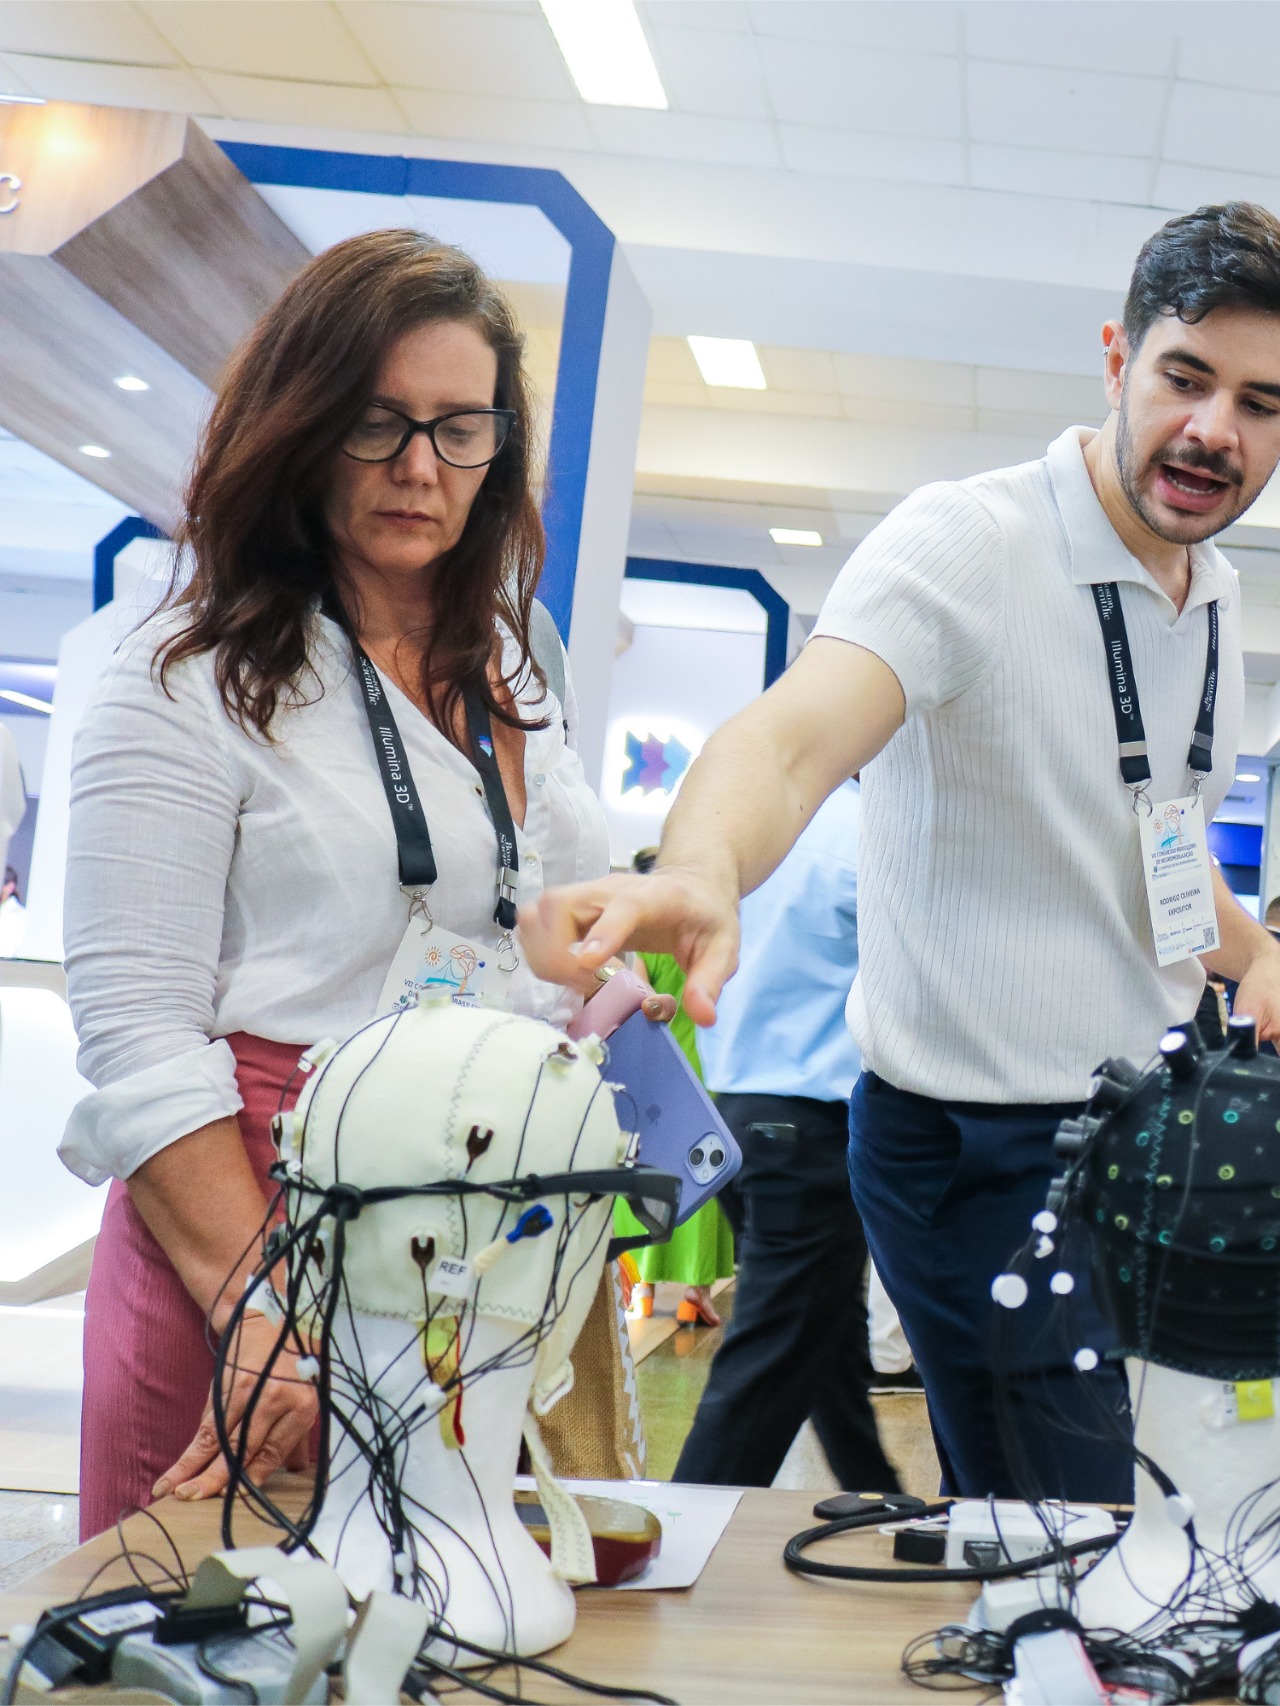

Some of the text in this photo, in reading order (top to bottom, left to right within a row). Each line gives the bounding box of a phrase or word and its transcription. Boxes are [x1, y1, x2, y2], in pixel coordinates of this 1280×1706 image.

[1097, 586, 1112, 620] ientific
[1104, 583, 1113, 609] oston
[1111, 640, 1127, 693] Illumina
[379, 726, 402, 780] Illumina
[1160, 888, 1201, 906] RODRIGO OLIVEIRA
[1168, 903, 1193, 916] EXPOSITOR
[440, 1261, 467, 1276] REF
